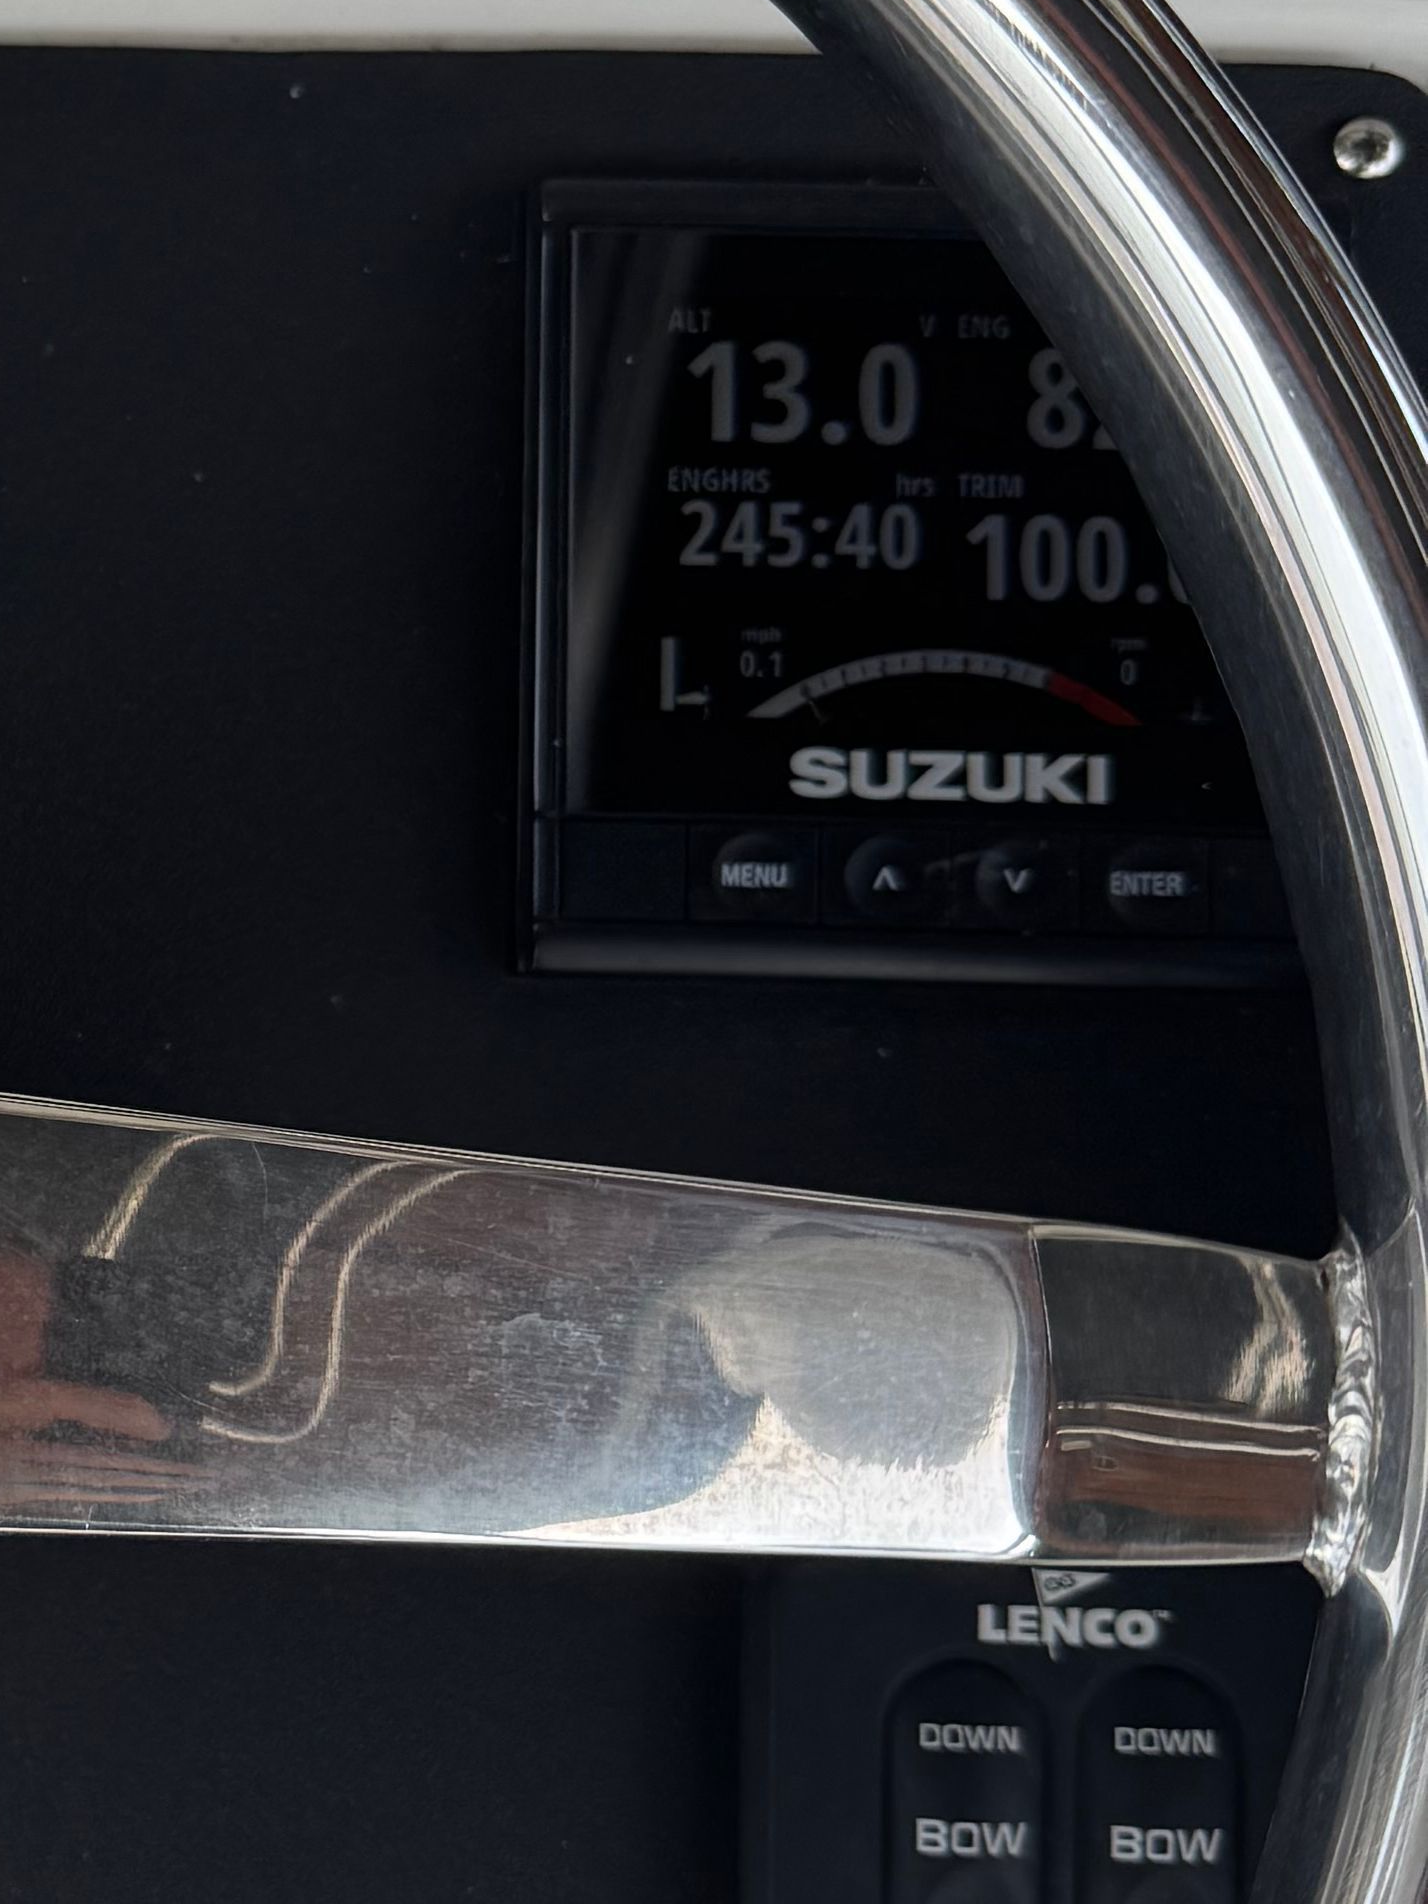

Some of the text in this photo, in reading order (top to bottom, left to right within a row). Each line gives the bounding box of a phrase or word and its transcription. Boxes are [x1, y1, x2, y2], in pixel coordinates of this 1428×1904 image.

[668, 307, 936, 338] ALT V
[958, 314, 1011, 339] ENG
[687, 340, 920, 445] 13.0
[1026, 347, 1119, 450] 8
[667, 466, 936, 497] ENGHRS hrs
[958, 474, 1024, 499] TRIM
[678, 499, 923, 570] 245:40
[965, 513, 1189, 606] 100.
[739, 650, 784, 678] 0.1
[1120, 659, 1137, 686] 0
[789, 745, 1111, 805] SUZUKI
[721, 863, 790, 889] MENU
[1109, 870, 1187, 897] ENTER
[918, 1722, 1022, 1752] DOWN
[1113, 1726, 1218, 1756] DOWN
[915, 1817, 1027, 1858] BOW
[1110, 1824, 1222, 1864] BOW
